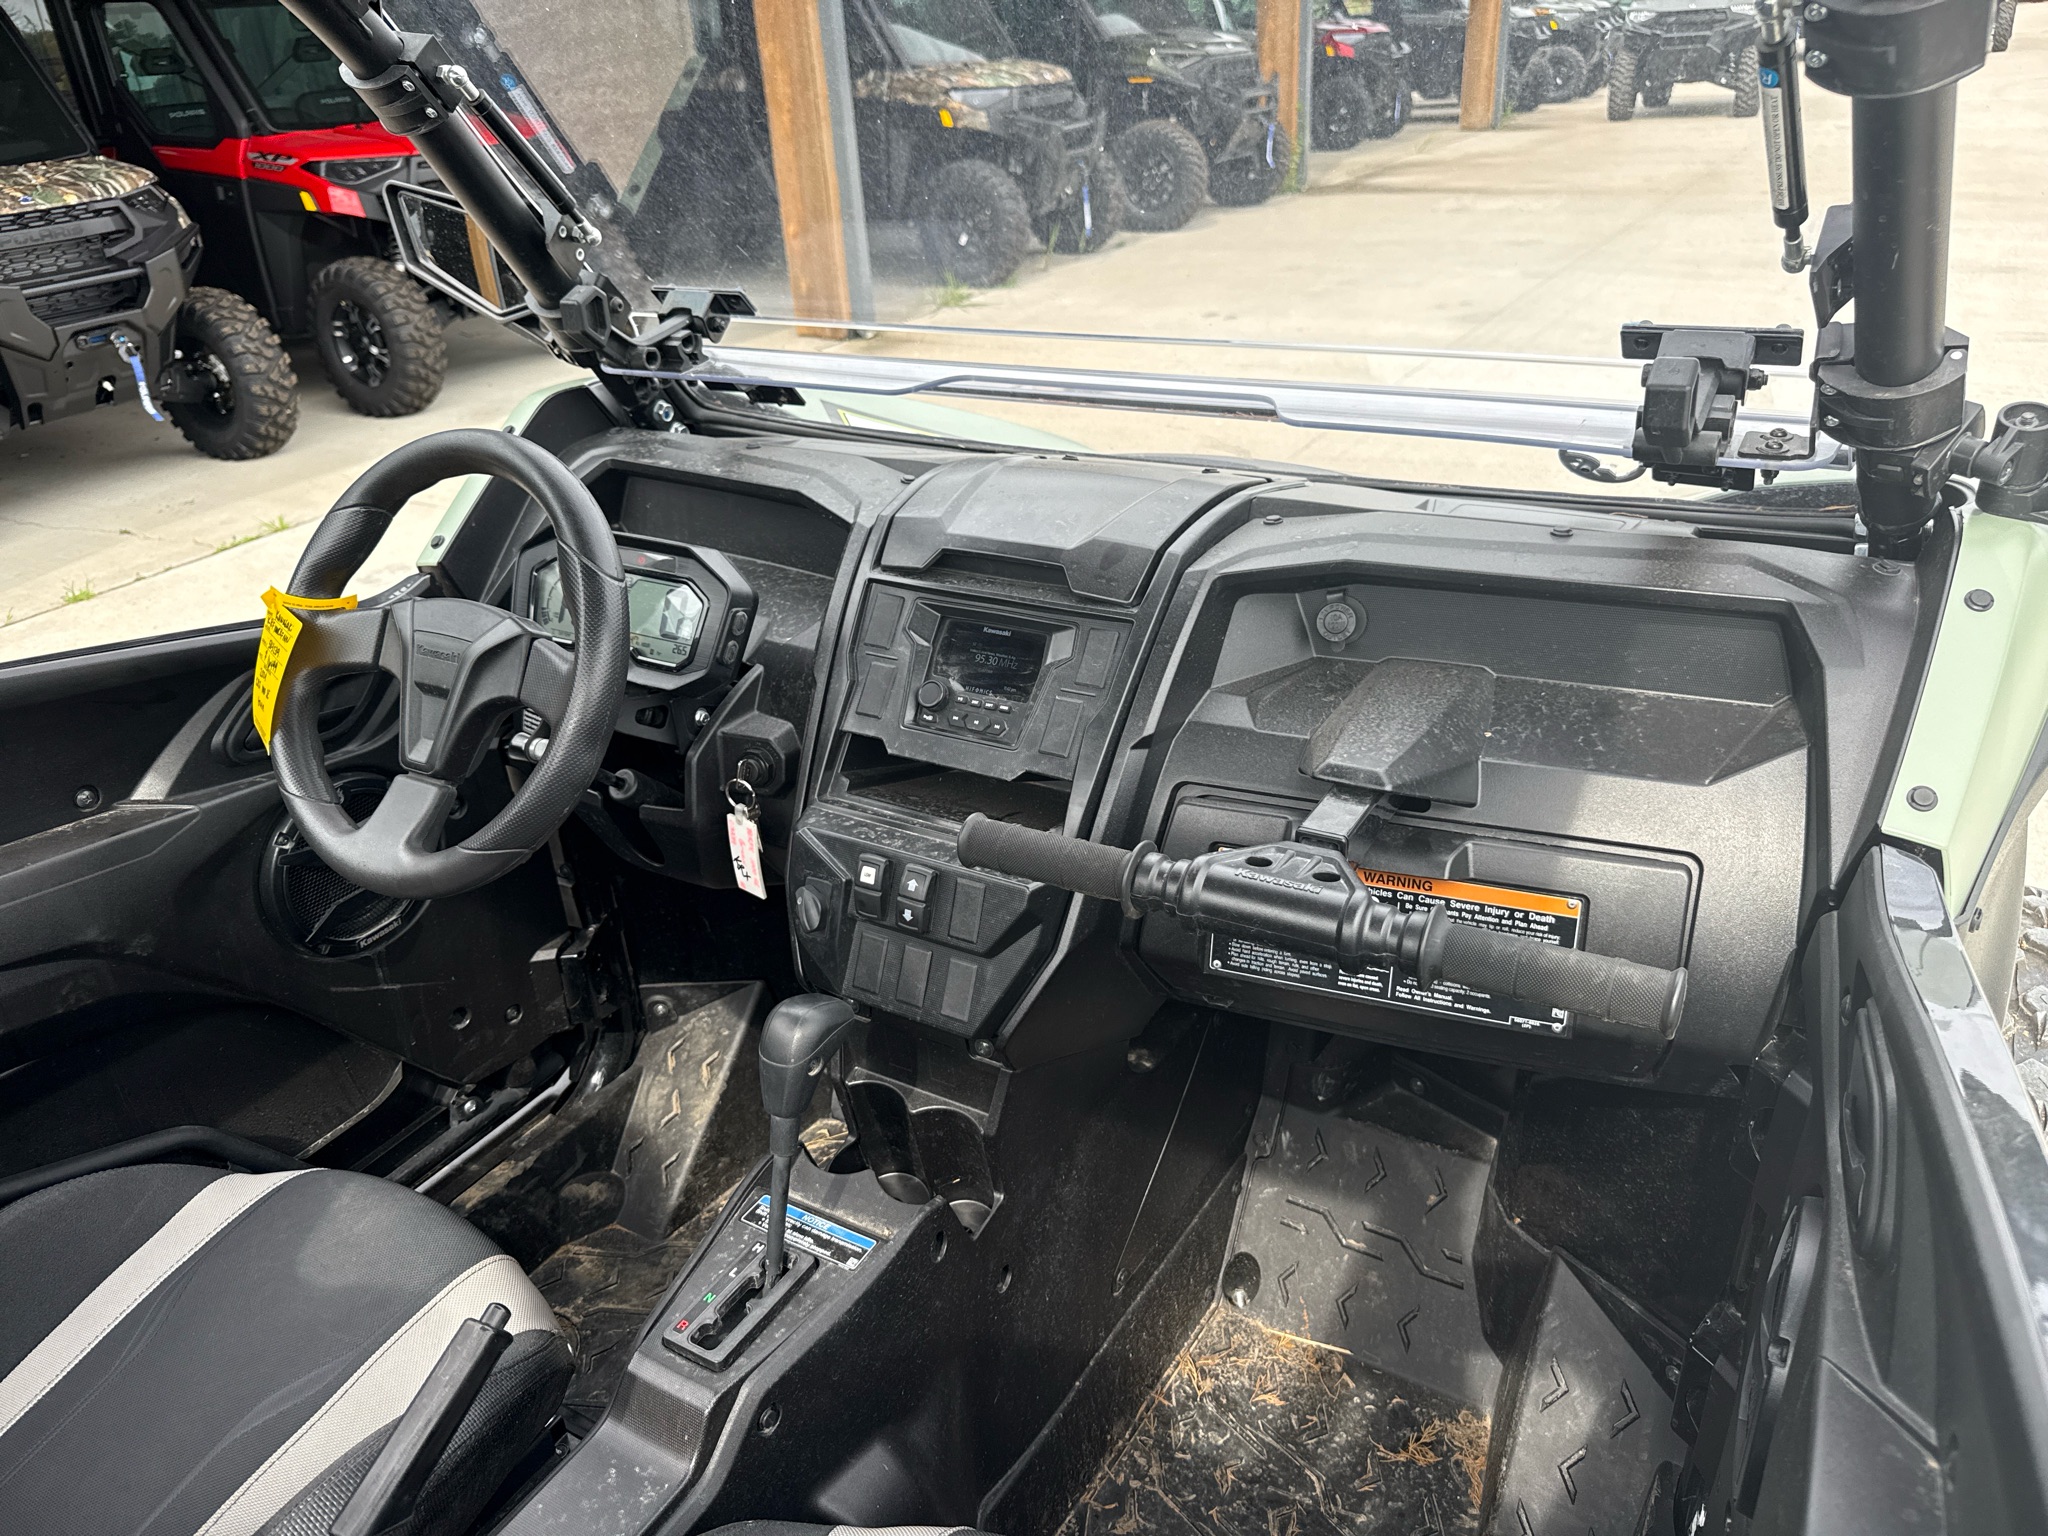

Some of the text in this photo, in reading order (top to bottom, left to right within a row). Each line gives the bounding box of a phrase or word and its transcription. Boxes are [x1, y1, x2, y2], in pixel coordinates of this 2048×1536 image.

[253, 151, 293, 162] XP
[982, 626, 1012, 637] Kawasaki
[416, 643, 461, 663] Kawasaki
[672, 644, 688, 656] 265
[974, 654, 998, 665] 95.30
[998, 658, 1018, 669] MHz
[1234, 868, 1324, 894] Kawasaki
[1364, 871, 1433, 891] WARNING
[1368, 887, 1392, 898] hicles
[1396, 892, 1414, 901] Can
[1418, 895, 1446, 905] Cause
[1450, 900, 1480, 912] Severe
[1484, 905, 1510, 918] Injury
[1528, 912, 1556, 924] Death
[1462, 912, 1472, 920] Pay
[1474, 914, 1500, 923] Attention
[1530, 923, 1548, 931] Ahead
[360, 917, 402, 948] Kawasaki
[1395, 991, 1412, 999] Follow
[1422, 996, 1452, 1007] Instructions
[1411, 988, 1432, 997] Owner's
[802, 1214, 831, 1230] NOTICE
[752, 1242, 765, 1253] H
[728, 1267, 738, 1278] L
[703, 1292, 716, 1303] N
[676, 1320, 689, 1331] R
